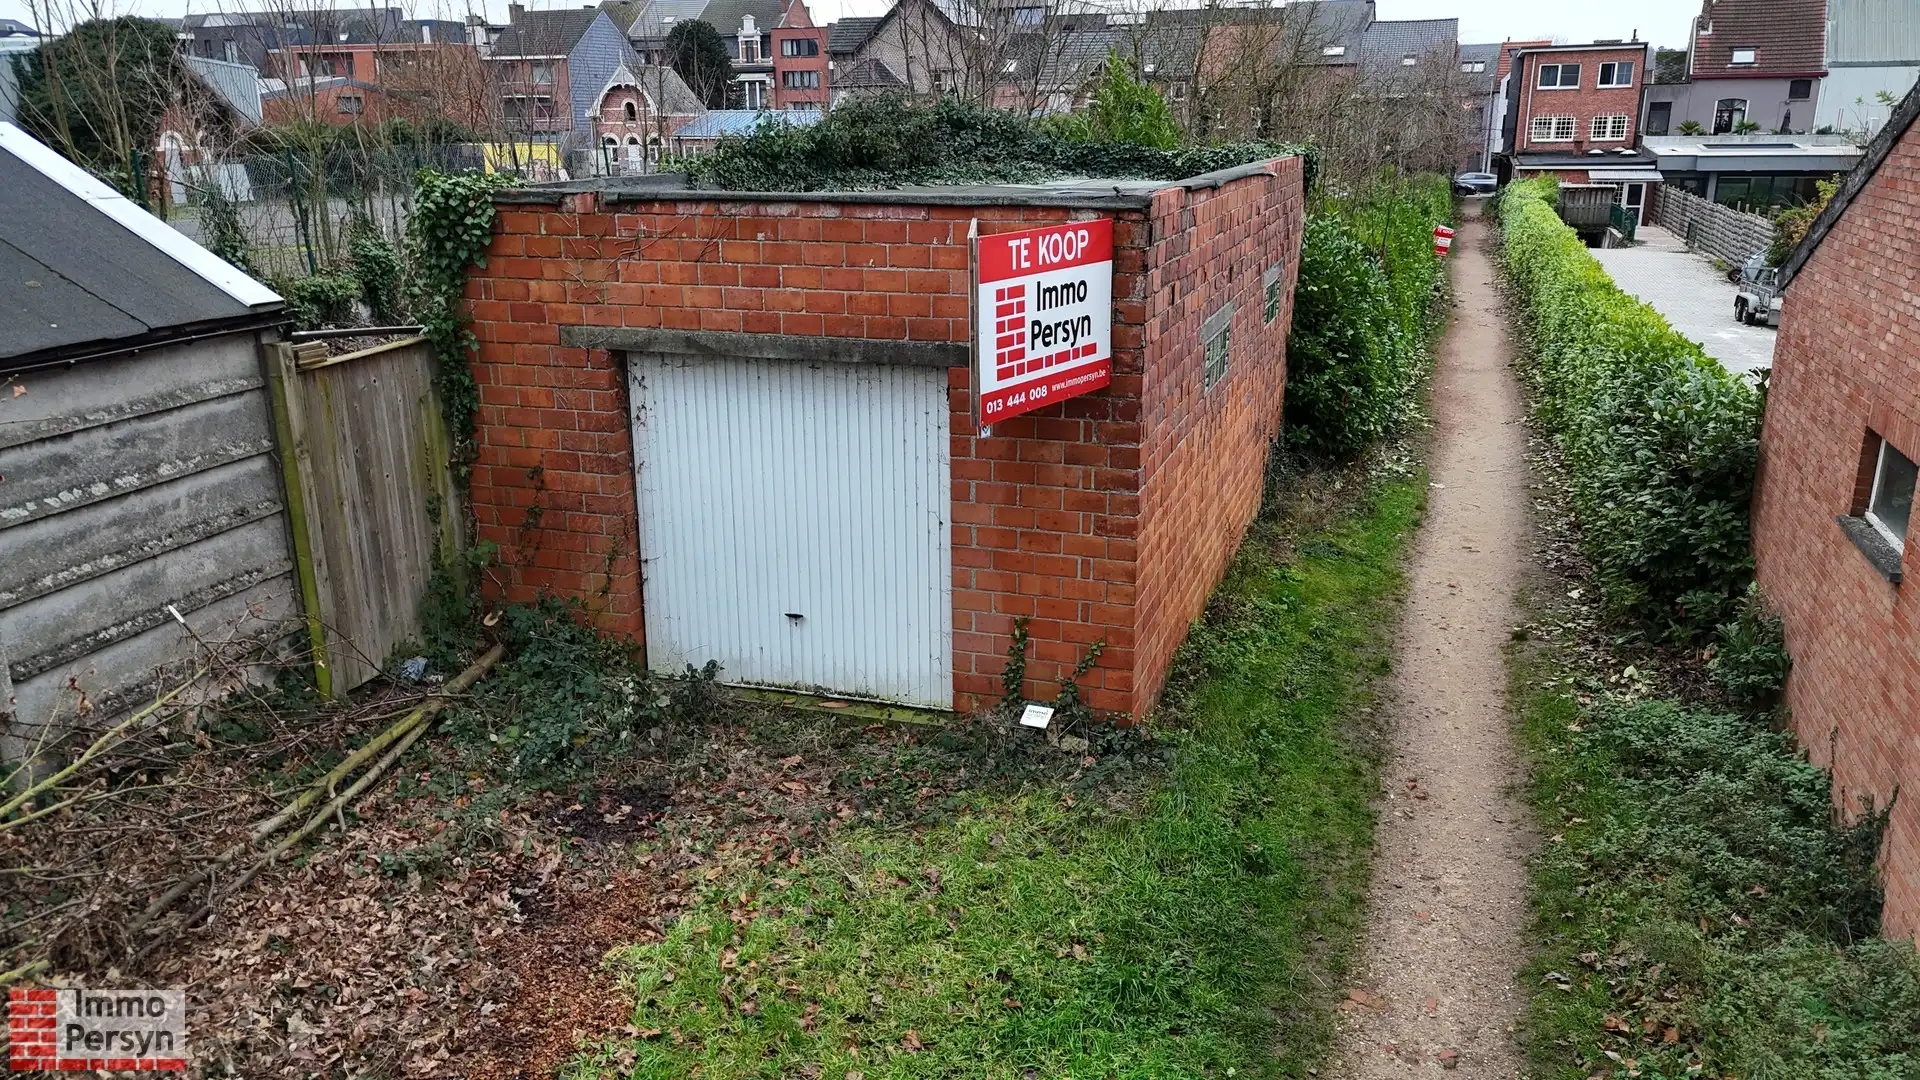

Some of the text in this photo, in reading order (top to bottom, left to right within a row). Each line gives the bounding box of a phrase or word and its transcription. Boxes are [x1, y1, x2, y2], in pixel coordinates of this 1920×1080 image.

[1008, 229, 1089, 270] TE KOOP
[1036, 279, 1088, 312] Immo
[1031, 314, 1091, 351] Persyn
[986, 369, 1106, 414] 013 444 008 www.immopersyn.be
